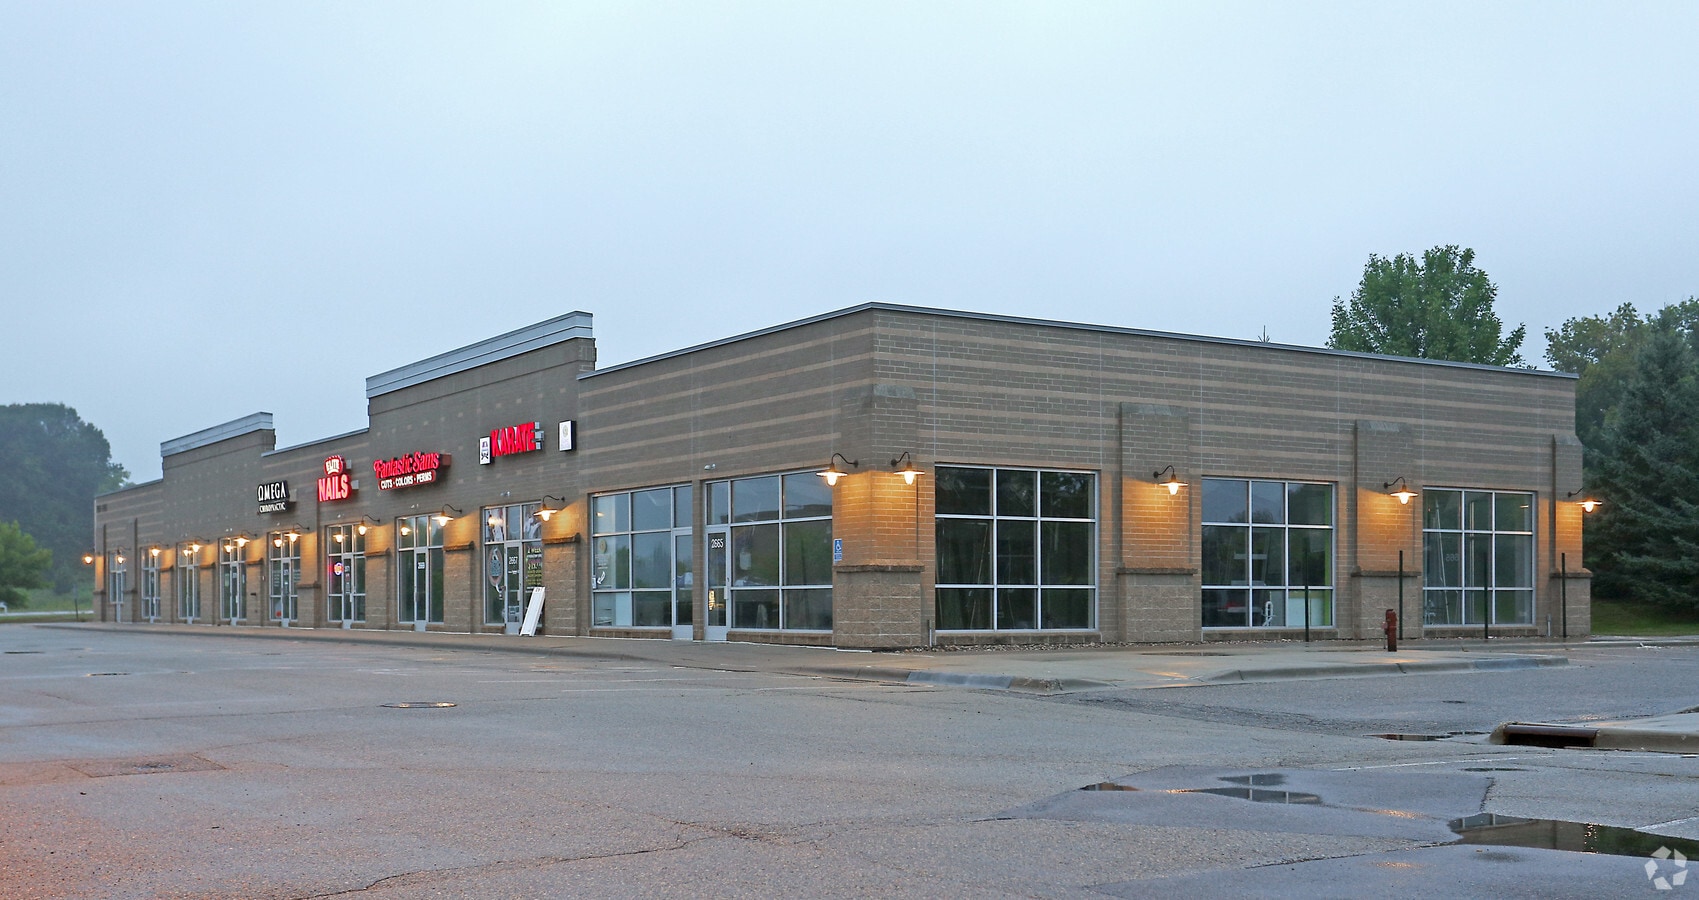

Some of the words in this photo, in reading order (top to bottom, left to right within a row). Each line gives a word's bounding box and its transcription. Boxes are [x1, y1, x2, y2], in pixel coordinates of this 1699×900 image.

[490, 421, 536, 457] KARATE
[373, 454, 412, 479] Fantastic
[413, 451, 440, 473] Sams
[318, 474, 348, 502] NAILS
[381, 479, 393, 489] CUTS
[395, 475, 413, 487] COLORS
[711, 538, 724, 549] 2665
